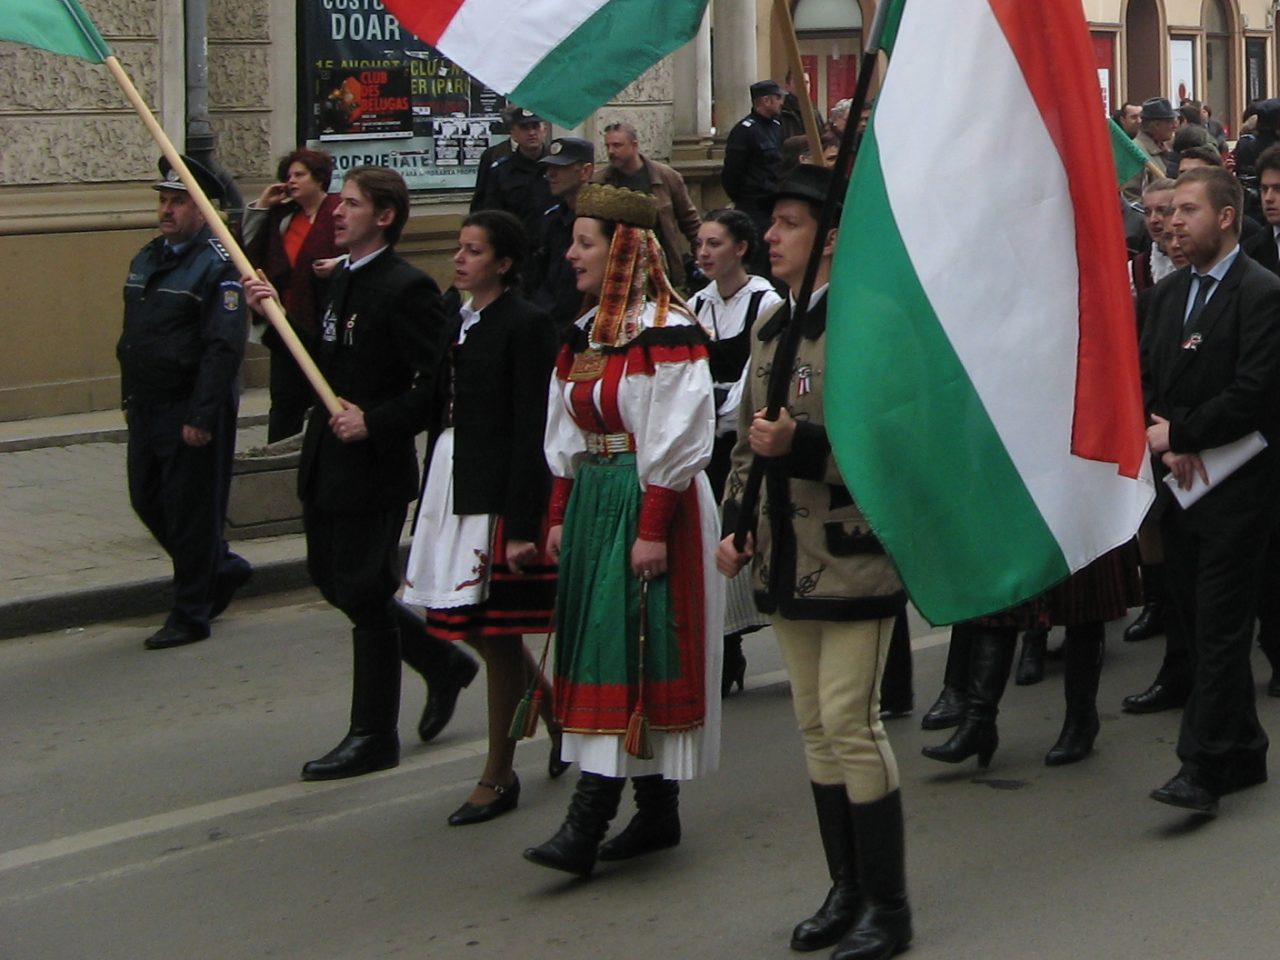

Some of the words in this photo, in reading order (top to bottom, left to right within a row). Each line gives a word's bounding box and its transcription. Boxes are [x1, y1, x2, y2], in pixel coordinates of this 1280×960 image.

[331, 13, 401, 41] DOAR
[361, 71, 388, 85] CLUB
[361, 84, 380, 97] DES
[411, 78, 428, 95] ER
[361, 97, 410, 111] BELUGAS
[331, 154, 429, 170] ROPRIETATE
